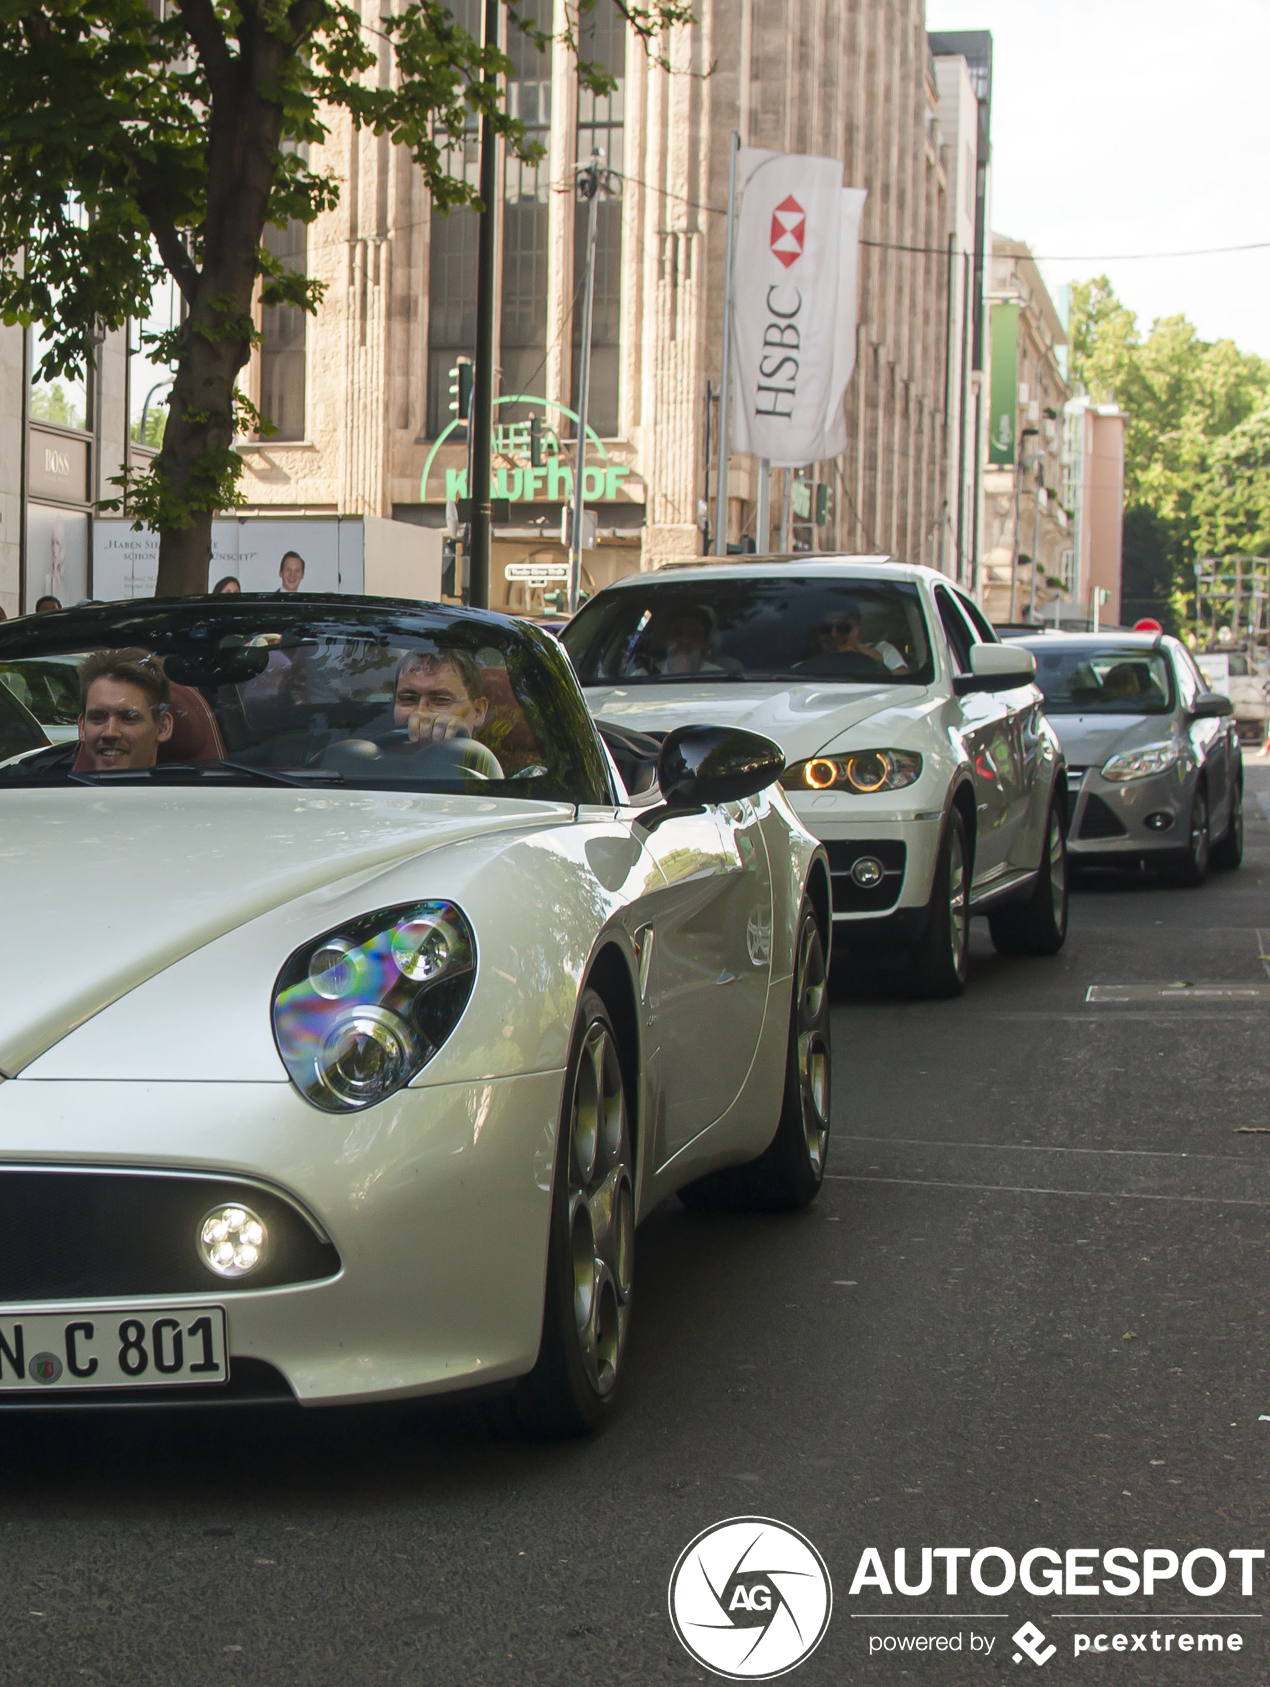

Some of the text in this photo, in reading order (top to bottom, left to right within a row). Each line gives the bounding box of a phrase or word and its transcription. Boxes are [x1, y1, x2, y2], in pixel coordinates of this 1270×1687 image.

[755, 284, 802, 420] HSBC
[45, 449, 70, 476] BOSS
[64, 1321, 98, 1378] C
[118, 1316, 219, 1376] 801
